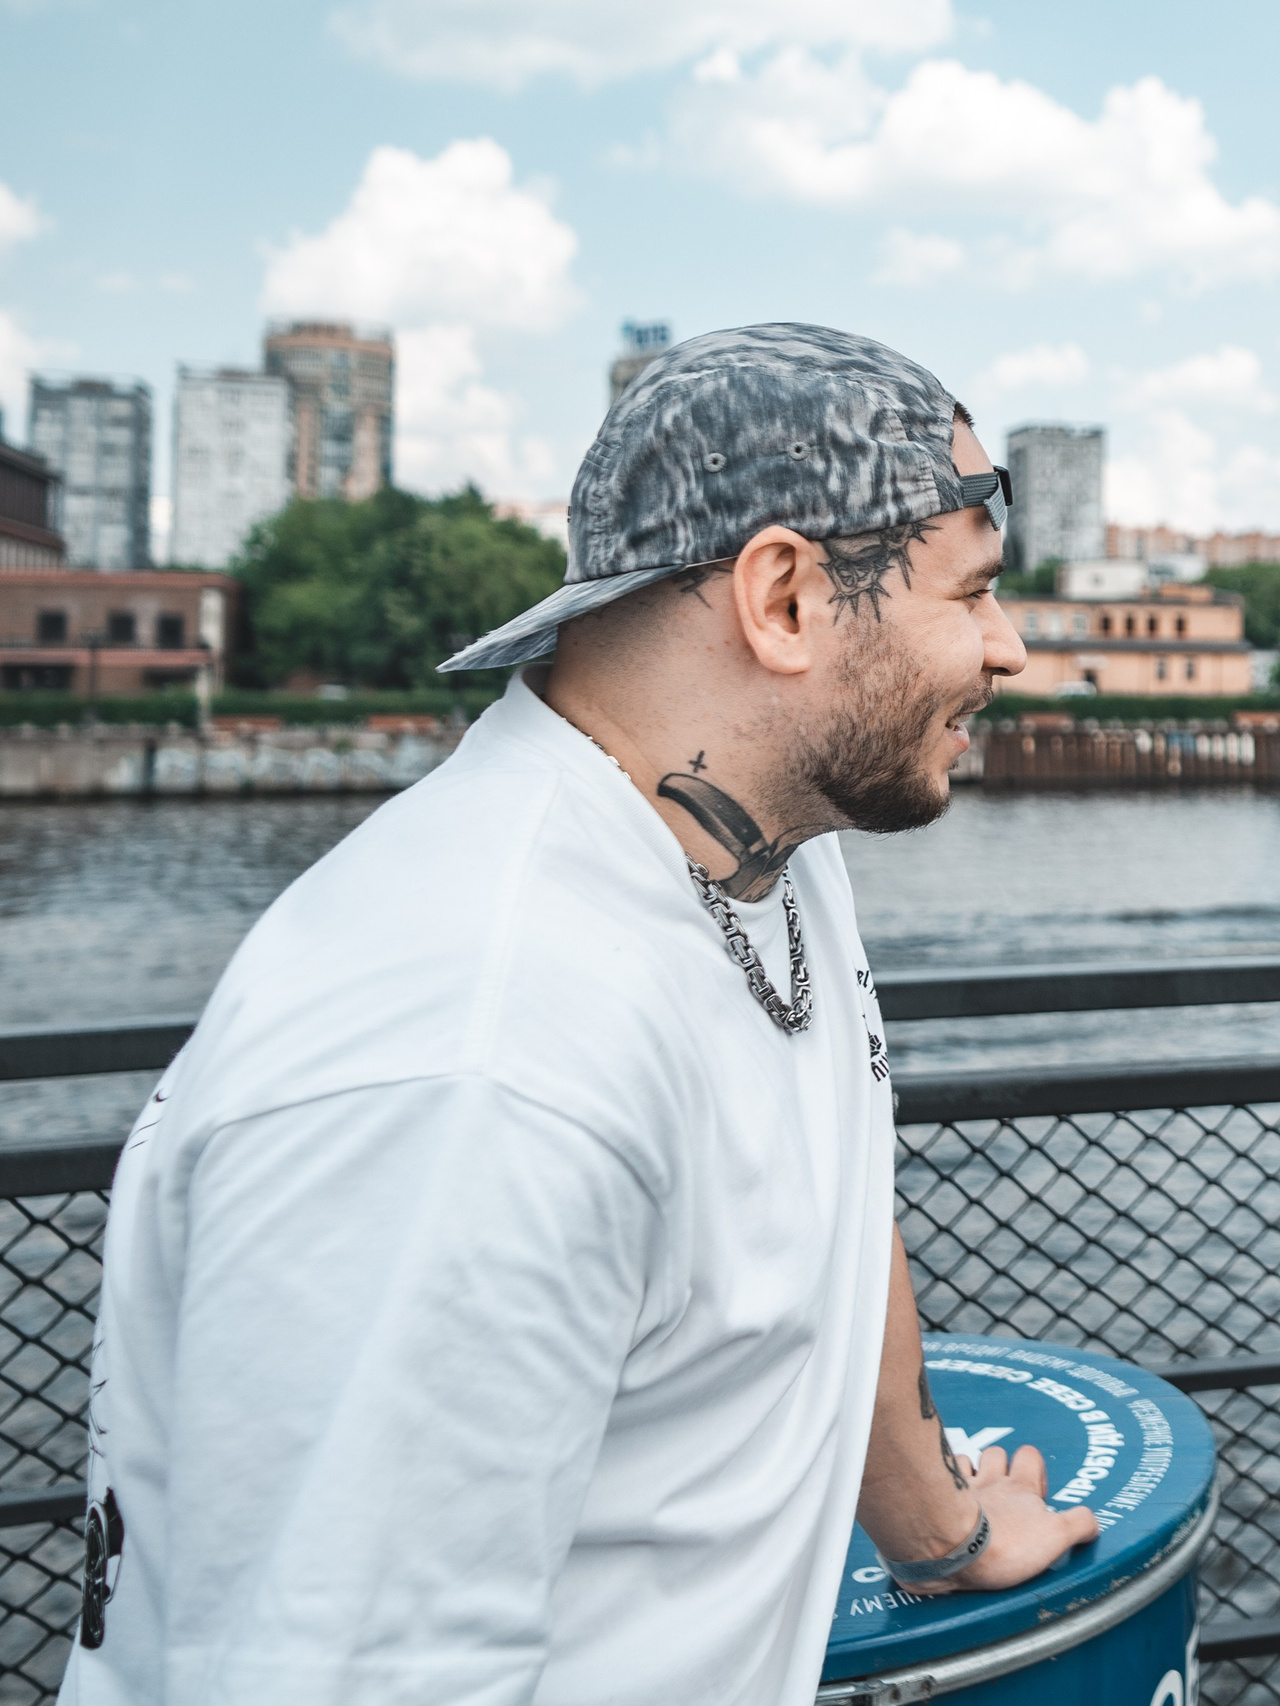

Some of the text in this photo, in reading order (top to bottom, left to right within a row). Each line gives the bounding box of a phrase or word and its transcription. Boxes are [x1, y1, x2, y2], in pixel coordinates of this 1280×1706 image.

[923, 1358, 1034, 1383] СЕВЕР
[1025, 1377, 1097, 1411] СЕБЕ
[1077, 1409, 1112, 1424] В
[1051, 1422, 1126, 1504] ПРОБУДИ
[1104, 1446, 1174, 1511] УПОТРЕБЛЕНИЕ
[850, 1589, 935, 1617] ШЕМУ
